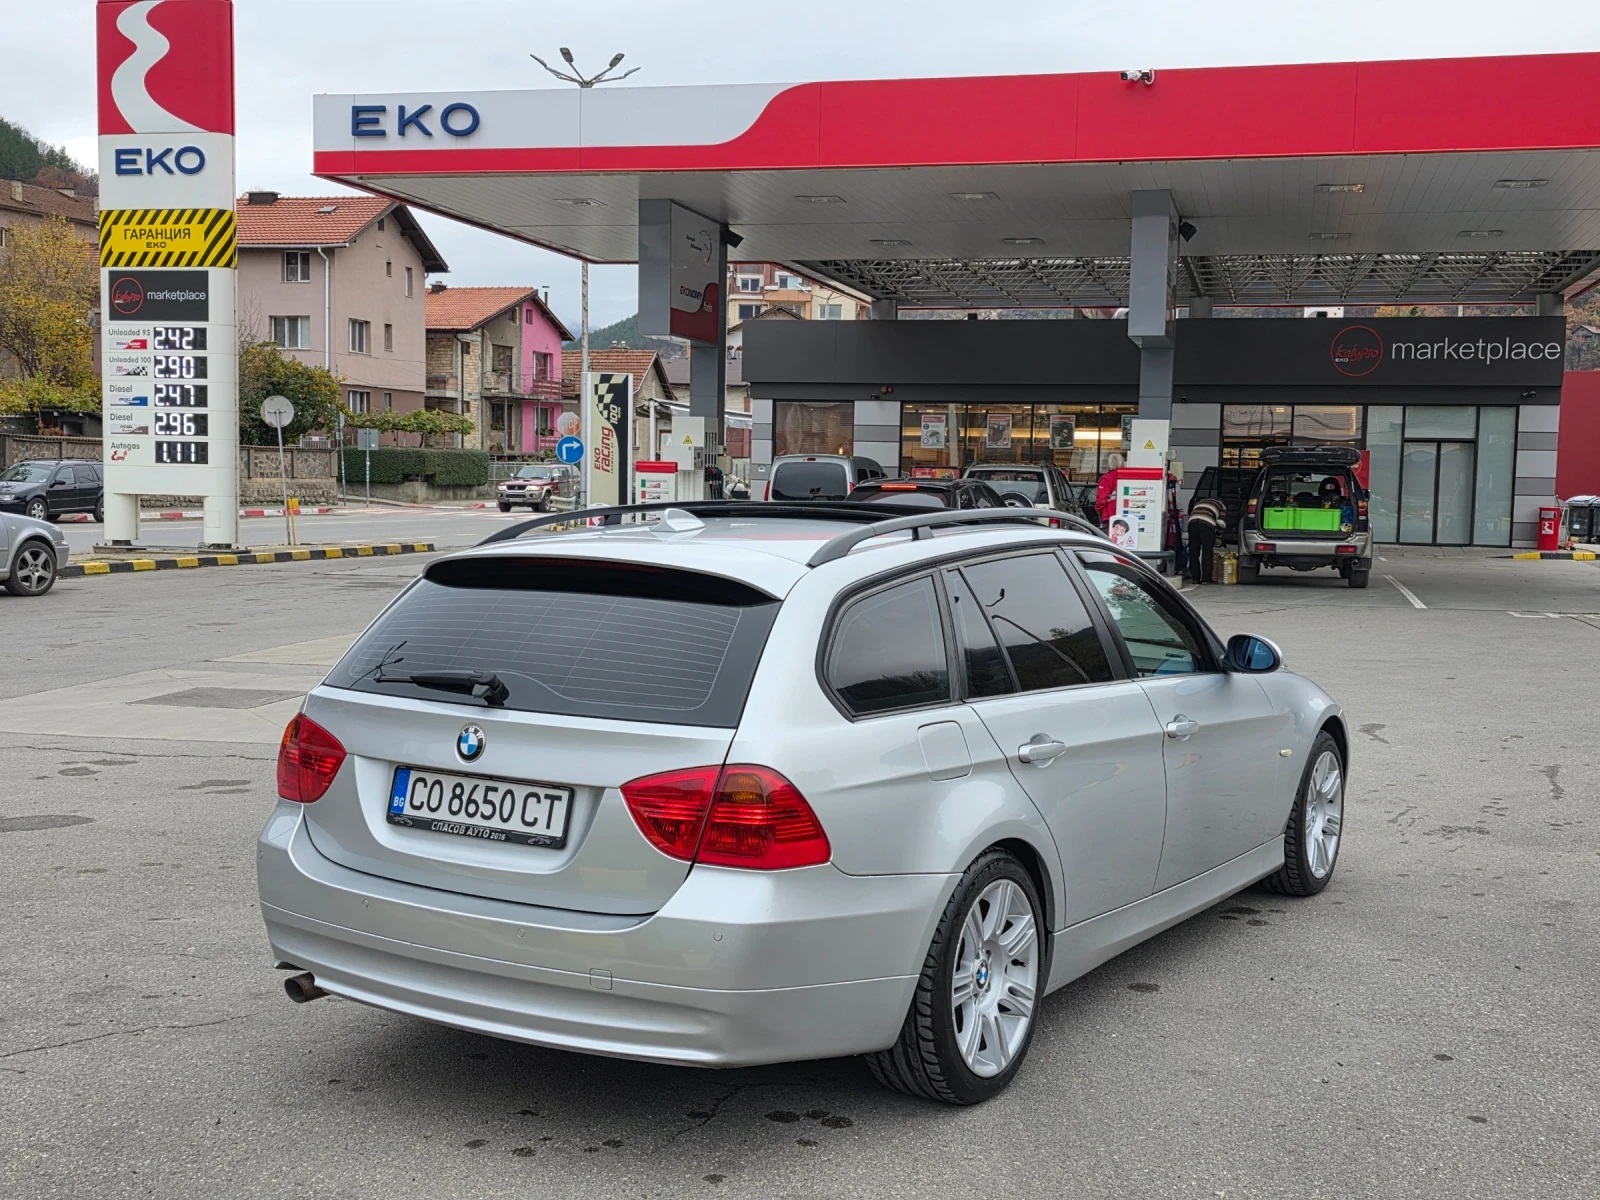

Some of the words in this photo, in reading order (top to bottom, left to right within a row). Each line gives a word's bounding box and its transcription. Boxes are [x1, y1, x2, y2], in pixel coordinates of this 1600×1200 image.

[352, 102, 480, 137] EKO
[114, 146, 206, 176] EKO
[123, 228, 191, 241] ГАРАНЦИЯ
[147, 290, 206, 302] marketplace
[108, 328, 140, 336] Unleaded
[154, 327, 194, 350] 2.42
[108, 356, 139, 364] Unleaded
[140, 356, 152, 364] 100
[1391, 337, 1561, 365] marketplace
[154, 356, 194, 378] 2.90
[109, 384, 133, 393] Diesel
[154, 384, 195, 406] 2.47
[109, 412, 133, 421] Diesel
[610, 404, 618, 424] 100
[155, 413, 195, 435] 2.96
[110, 442, 140, 451] Autogas
[601, 426, 614, 473] racing
[393, 796, 405, 807] BG
[431, 821, 466, 835] СПАСОВ
[466, 827, 490, 839] АУТО
